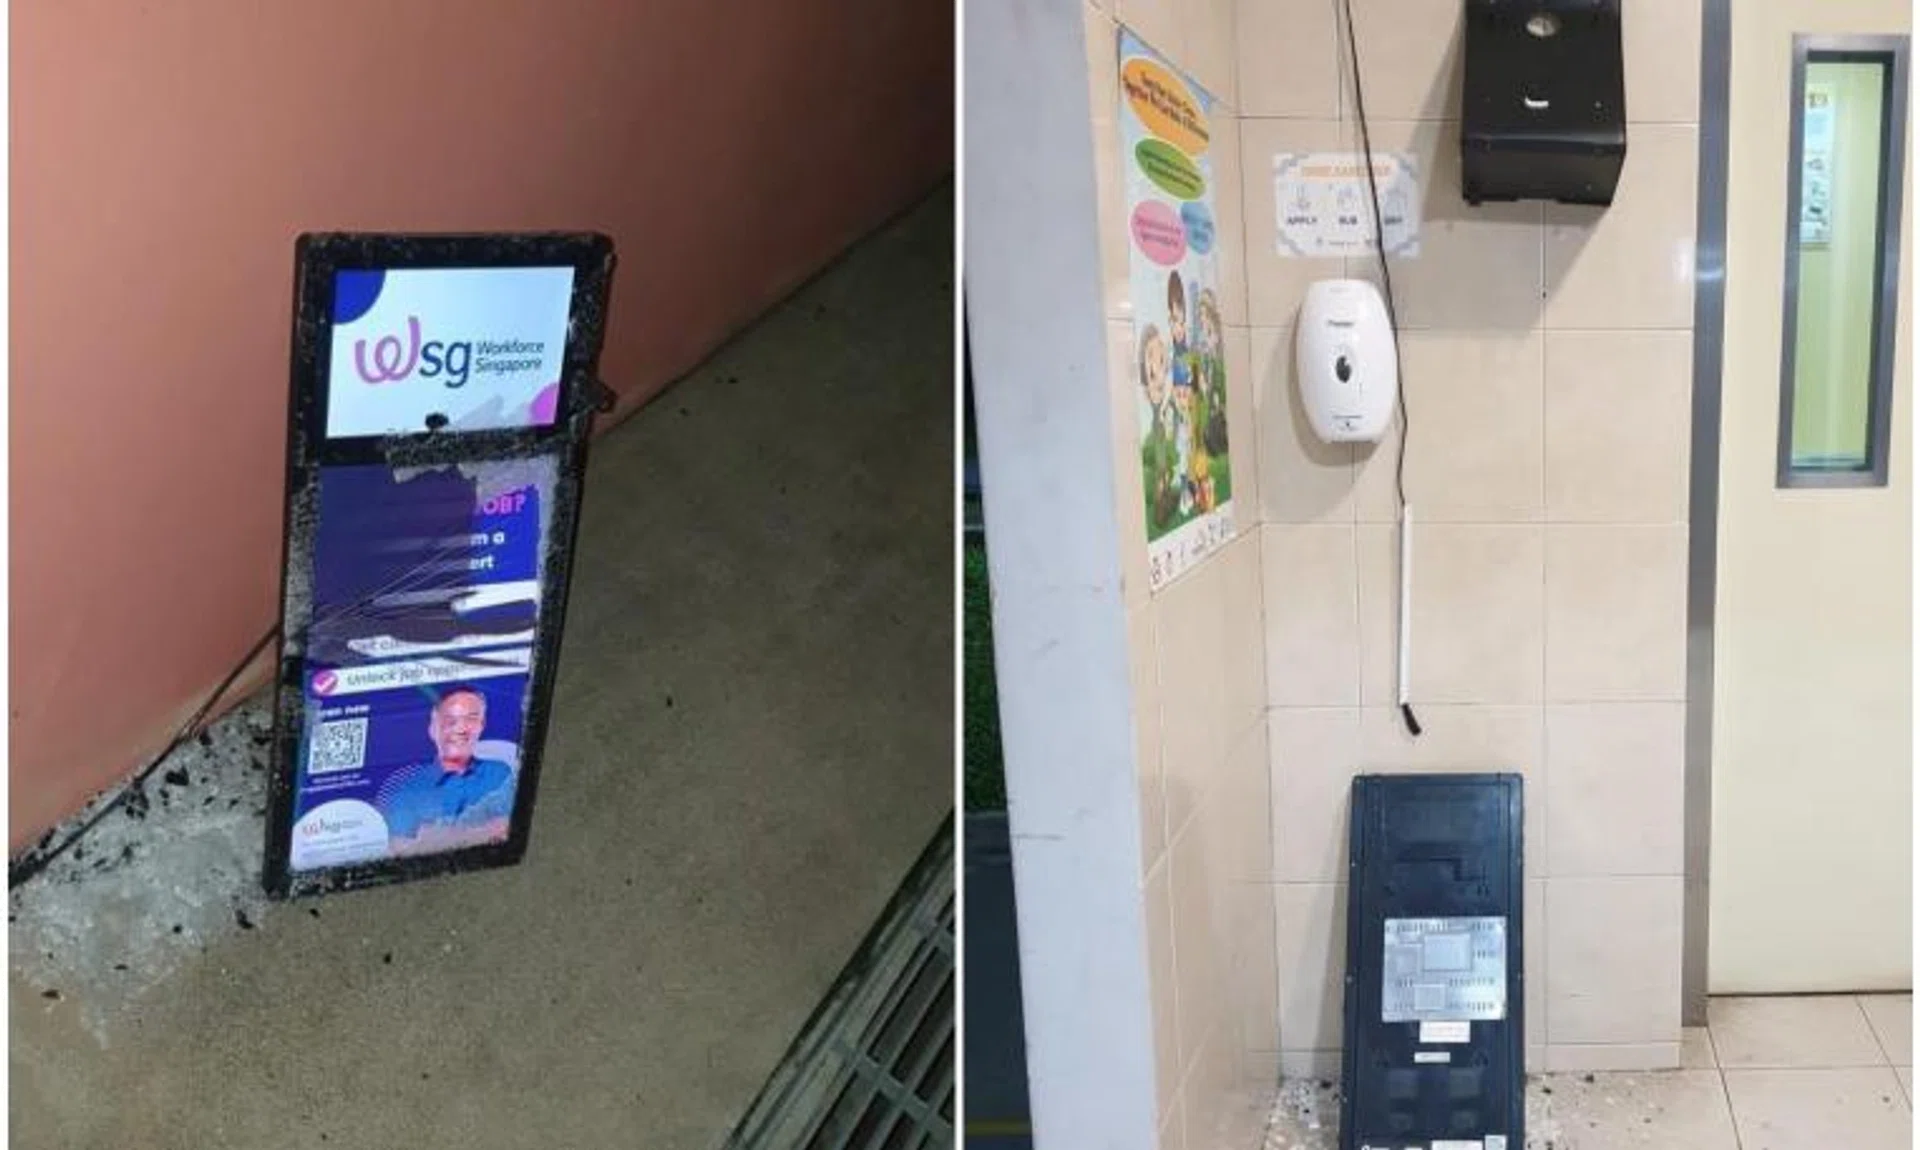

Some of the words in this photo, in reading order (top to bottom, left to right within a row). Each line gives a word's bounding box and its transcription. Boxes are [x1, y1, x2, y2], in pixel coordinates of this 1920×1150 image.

[476, 337, 545, 355] Workforce
[475, 357, 543, 374] Singapore
[479, 493, 526, 515] OB?
